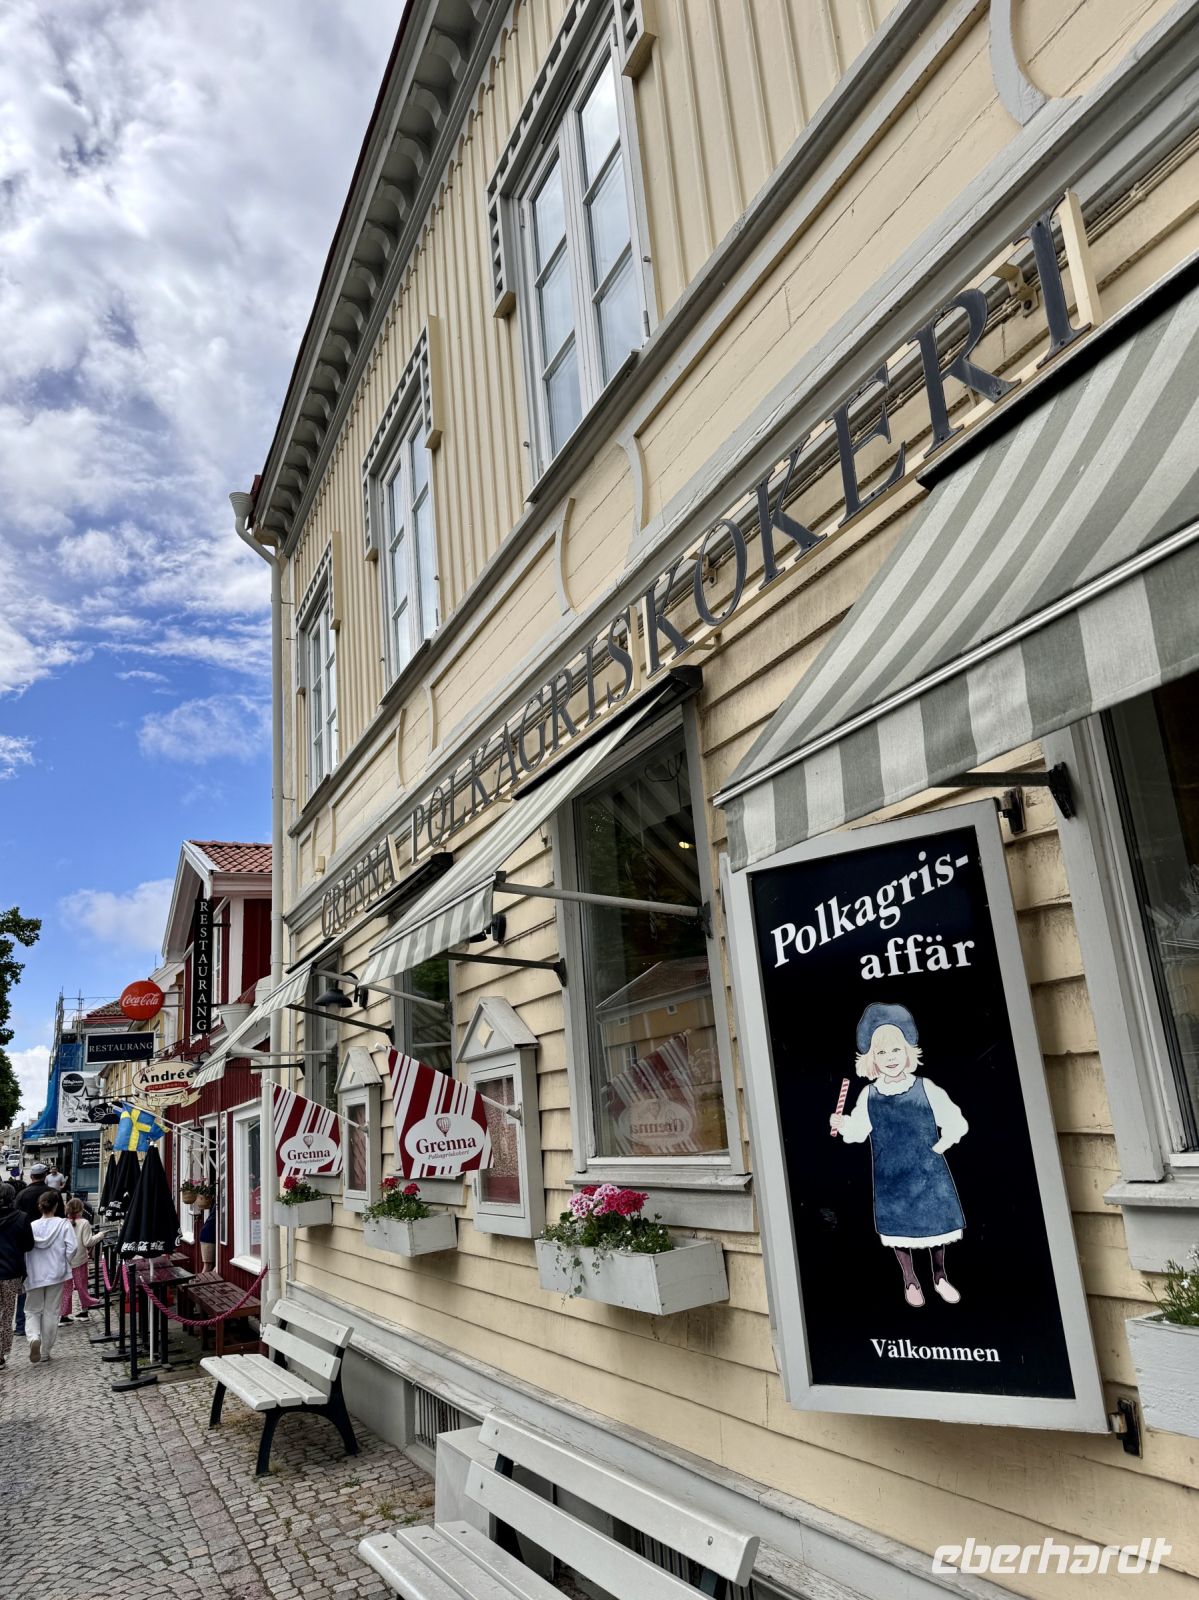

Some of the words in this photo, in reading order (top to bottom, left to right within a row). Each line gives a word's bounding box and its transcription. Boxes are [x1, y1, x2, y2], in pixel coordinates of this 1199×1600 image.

[321, 834, 399, 938] GRENNA
[410, 190, 1093, 866] POLKAGRISKOKERI
[770, 850, 970, 968] Polkagris-
[196, 901, 209, 1031] RESTAURANG
[860, 935, 976, 981] affär
[89, 1042, 153, 1053] RESTAURANG
[287, 1149, 331, 1161] Grenna
[416, 1137, 477, 1154] Grenna
[870, 1338, 1001, 1363] Välkommen
